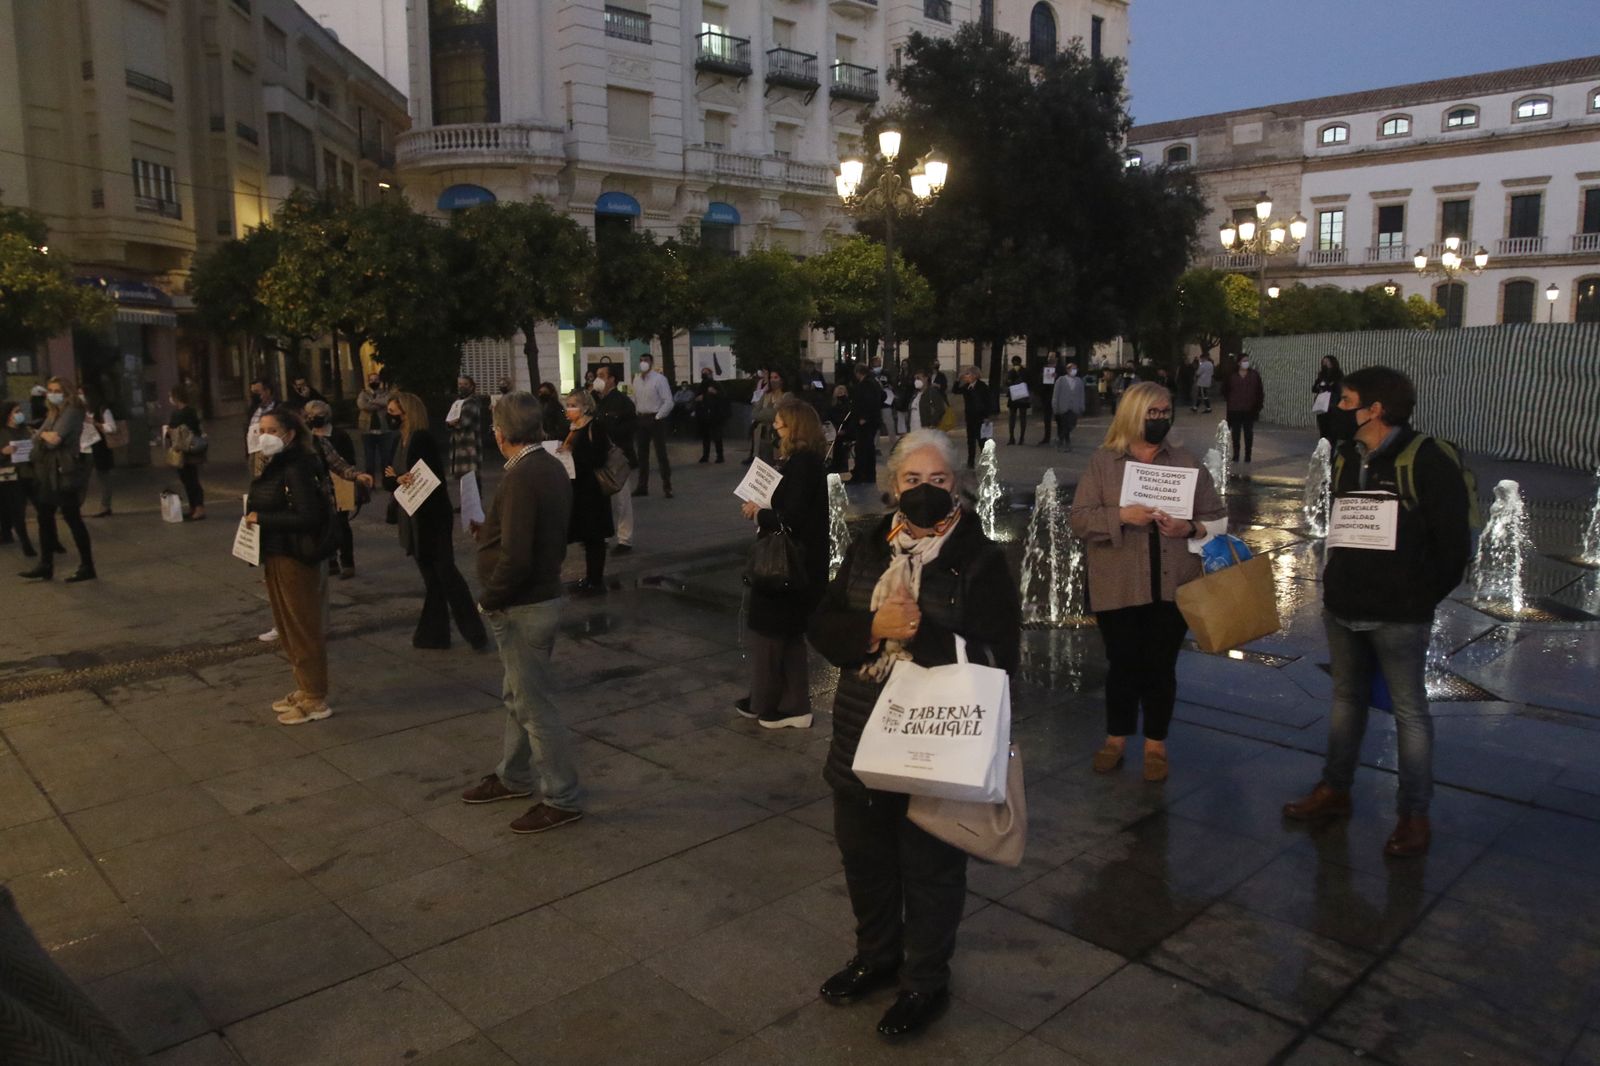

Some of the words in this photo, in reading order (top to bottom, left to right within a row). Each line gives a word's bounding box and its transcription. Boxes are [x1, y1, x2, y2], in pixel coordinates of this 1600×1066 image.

[1135, 468, 1160, 477] TODOS
[1138, 476, 1181, 485] ESENCIALES
[1141, 484, 1177, 494] IGUALDAD
[1133, 491, 1181, 502] CONDICIONES
[908, 704, 986, 720] TABERNA
